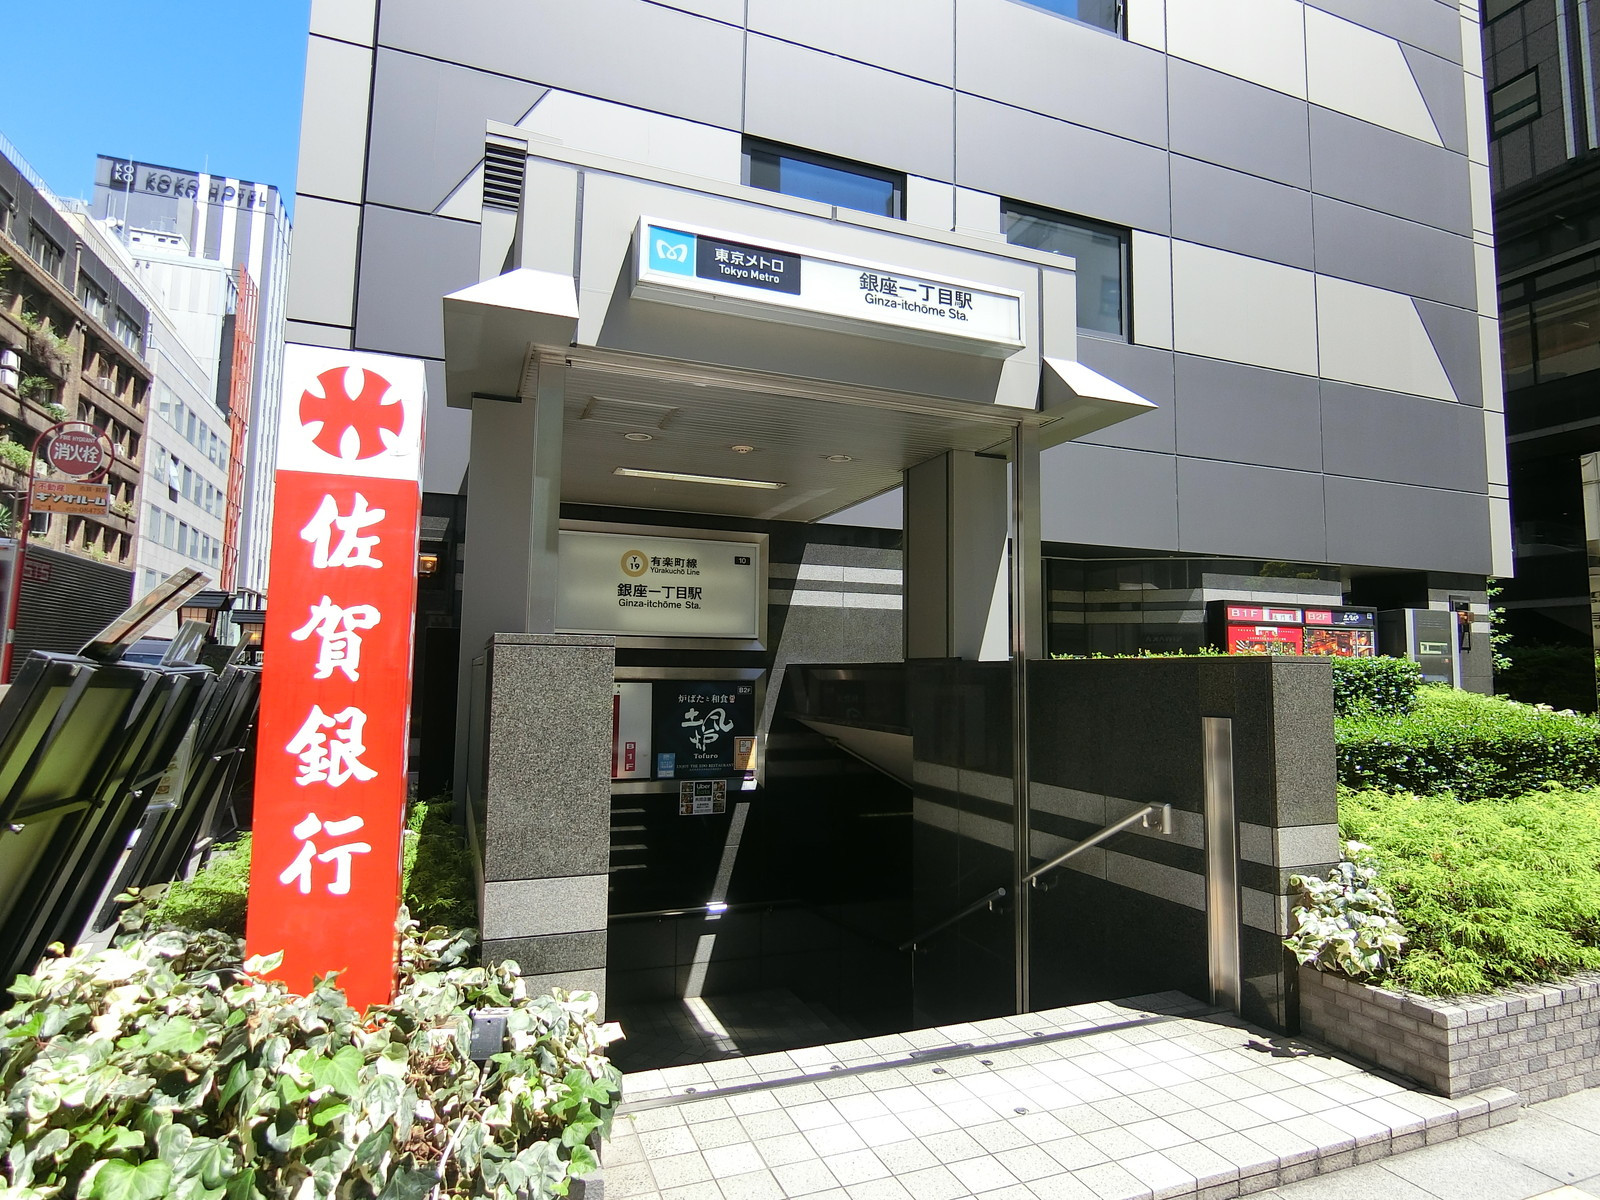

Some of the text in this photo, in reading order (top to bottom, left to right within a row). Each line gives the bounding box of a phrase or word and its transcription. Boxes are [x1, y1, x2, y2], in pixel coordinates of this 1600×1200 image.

[114, 172, 134, 182] KO
[116, 162, 135, 173] KO
[146, 171, 269, 208] KOKO HOTEL
[714, 248, 784, 273] 東京メトロ
[719, 264, 780, 284] Tokyo Metro
[859, 272, 973, 310] 銀座一丁目駅
[864, 293, 969, 321] Ginza-itchōme Sta.
[53, 442, 100, 464] 消火栓
[650, 556, 698, 568] 有楽町線
[617, 583, 702, 600] 銀座一丁目駅
[618, 598, 702, 609] Ginza-itchōme Sta.
[1231, 608, 1258, 618] B1F
[1307, 612, 1328, 621] B2F
[278, 491, 387, 896] 佐賀銀行
[626, 743, 635, 770] B1F
